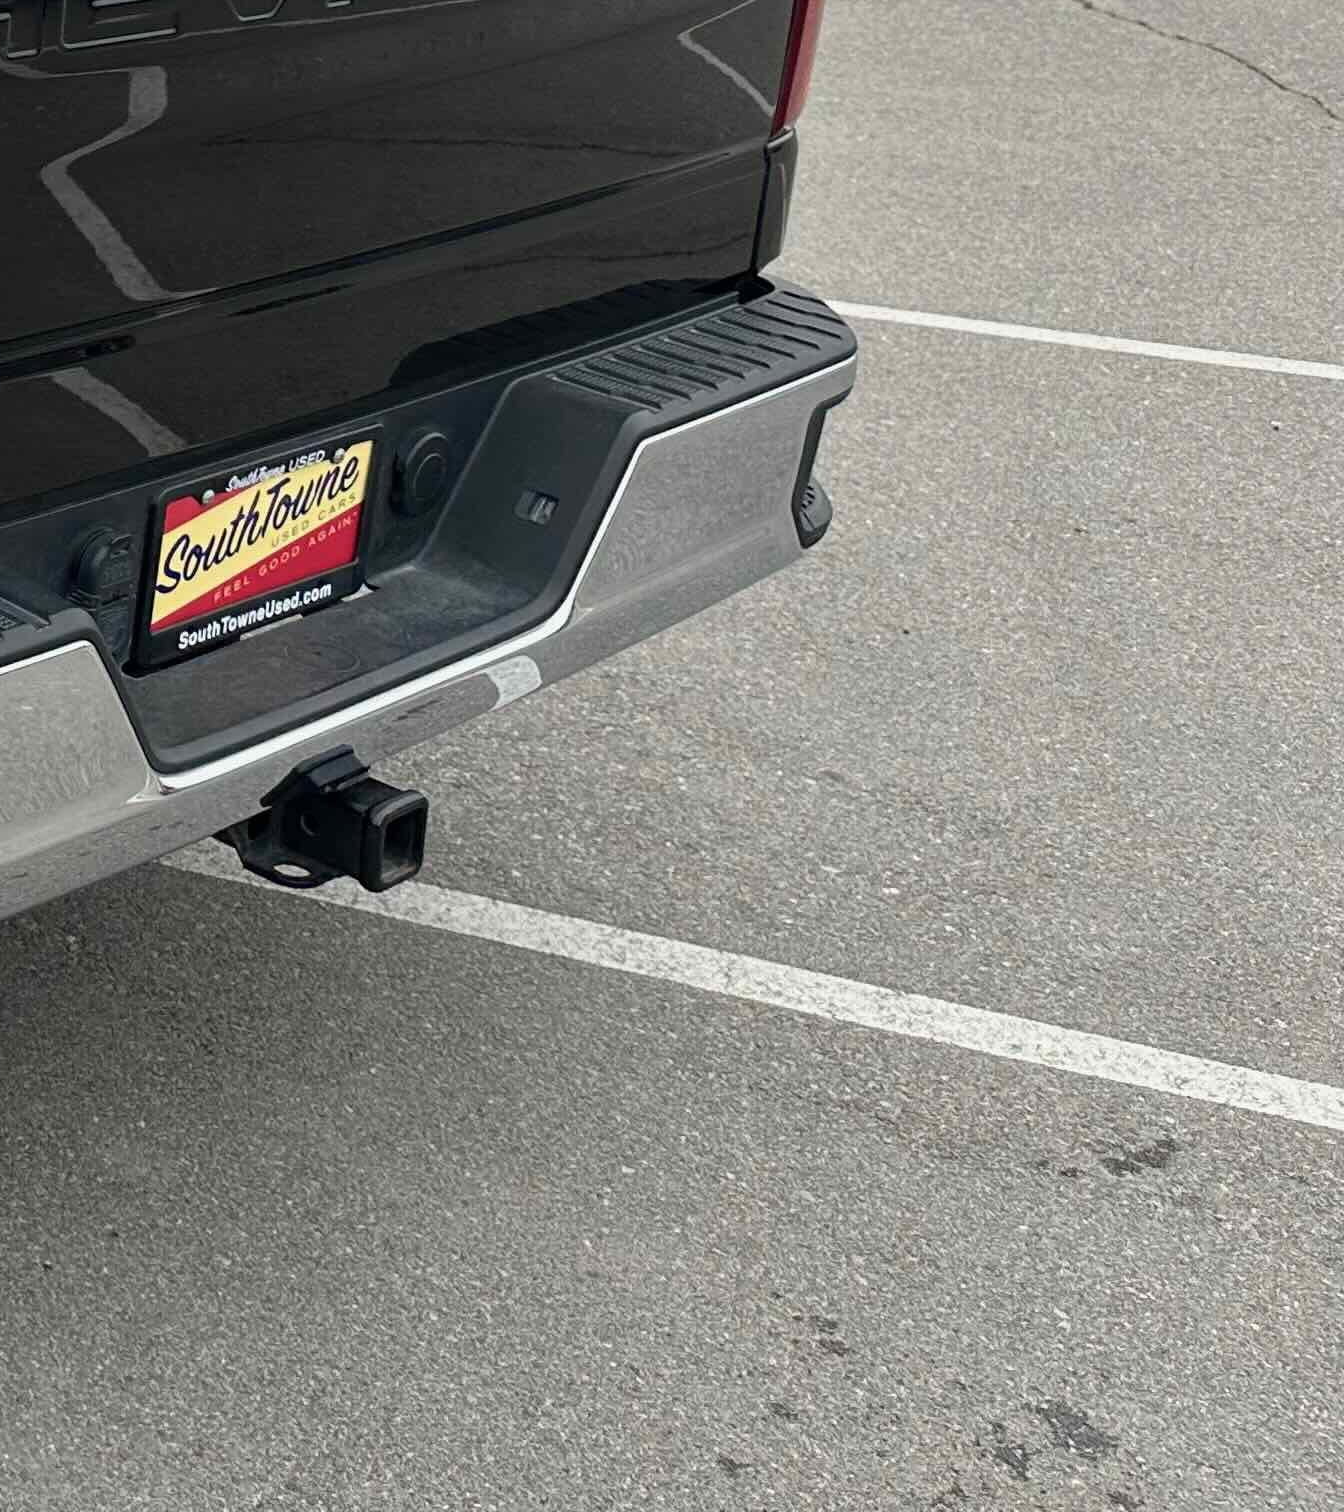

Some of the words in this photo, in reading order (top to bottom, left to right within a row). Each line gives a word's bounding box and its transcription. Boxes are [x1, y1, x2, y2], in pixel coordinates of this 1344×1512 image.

[288, 449, 326, 473] USED
[155, 455, 359, 595] SouthTowne
[271, 519, 310, 548] USED
[318, 493, 357, 521] CARS
[214, 576, 252, 602] FEEL
[258, 545, 302, 577] GOOD
[177, 582, 332, 650] SouthTowneUsed.com
